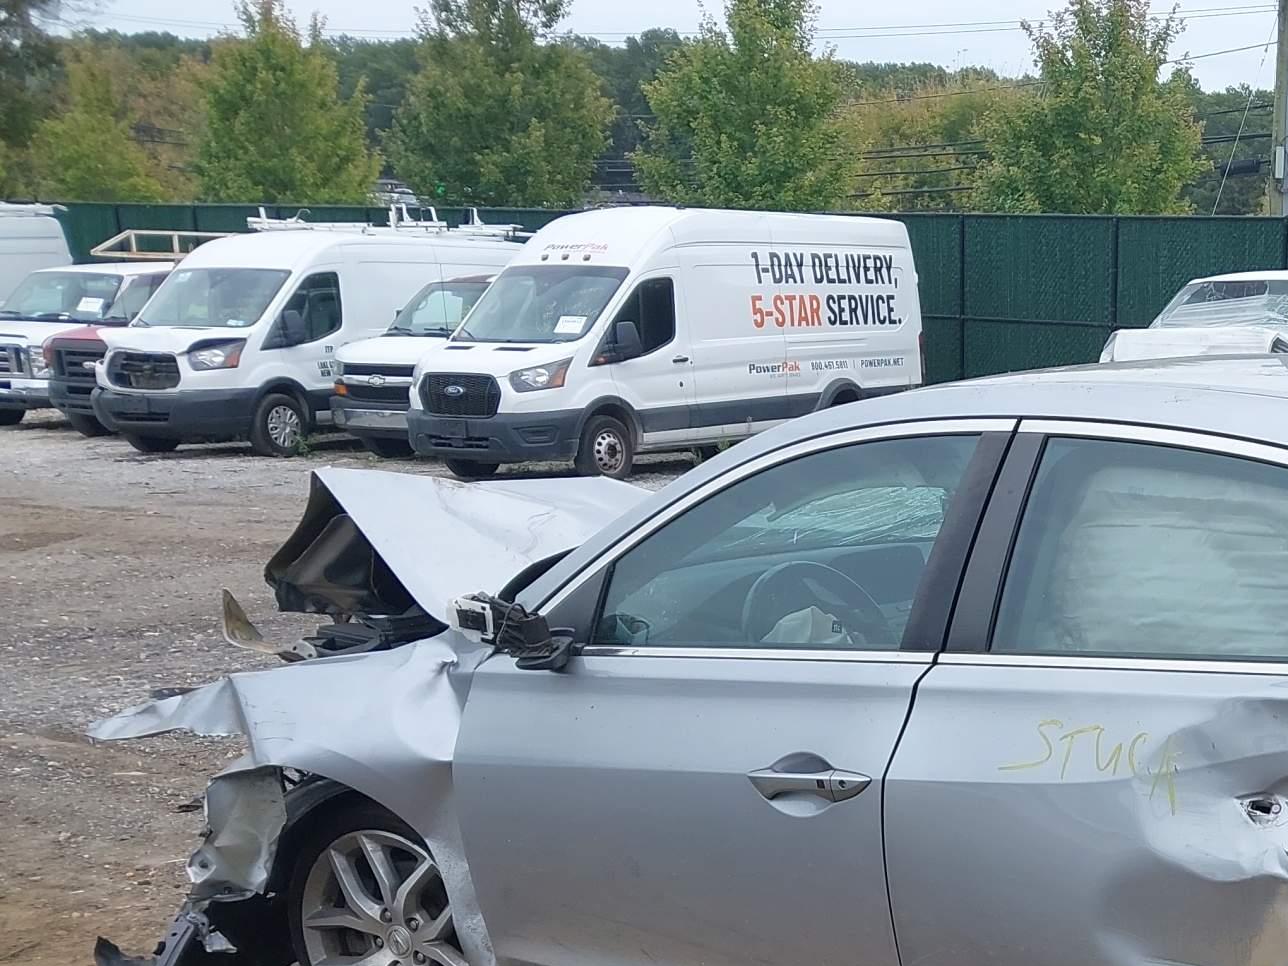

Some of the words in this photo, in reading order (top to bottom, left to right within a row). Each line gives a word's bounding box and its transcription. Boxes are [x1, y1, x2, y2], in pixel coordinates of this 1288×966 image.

[750, 251, 804, 285] 1-DAY
[810, 252, 898, 288] DELIVERY,
[751, 294, 822, 328] 5-STAR
[826, 293, 902, 325] SERVICE.
[748, 361, 801, 373] PowerPak
